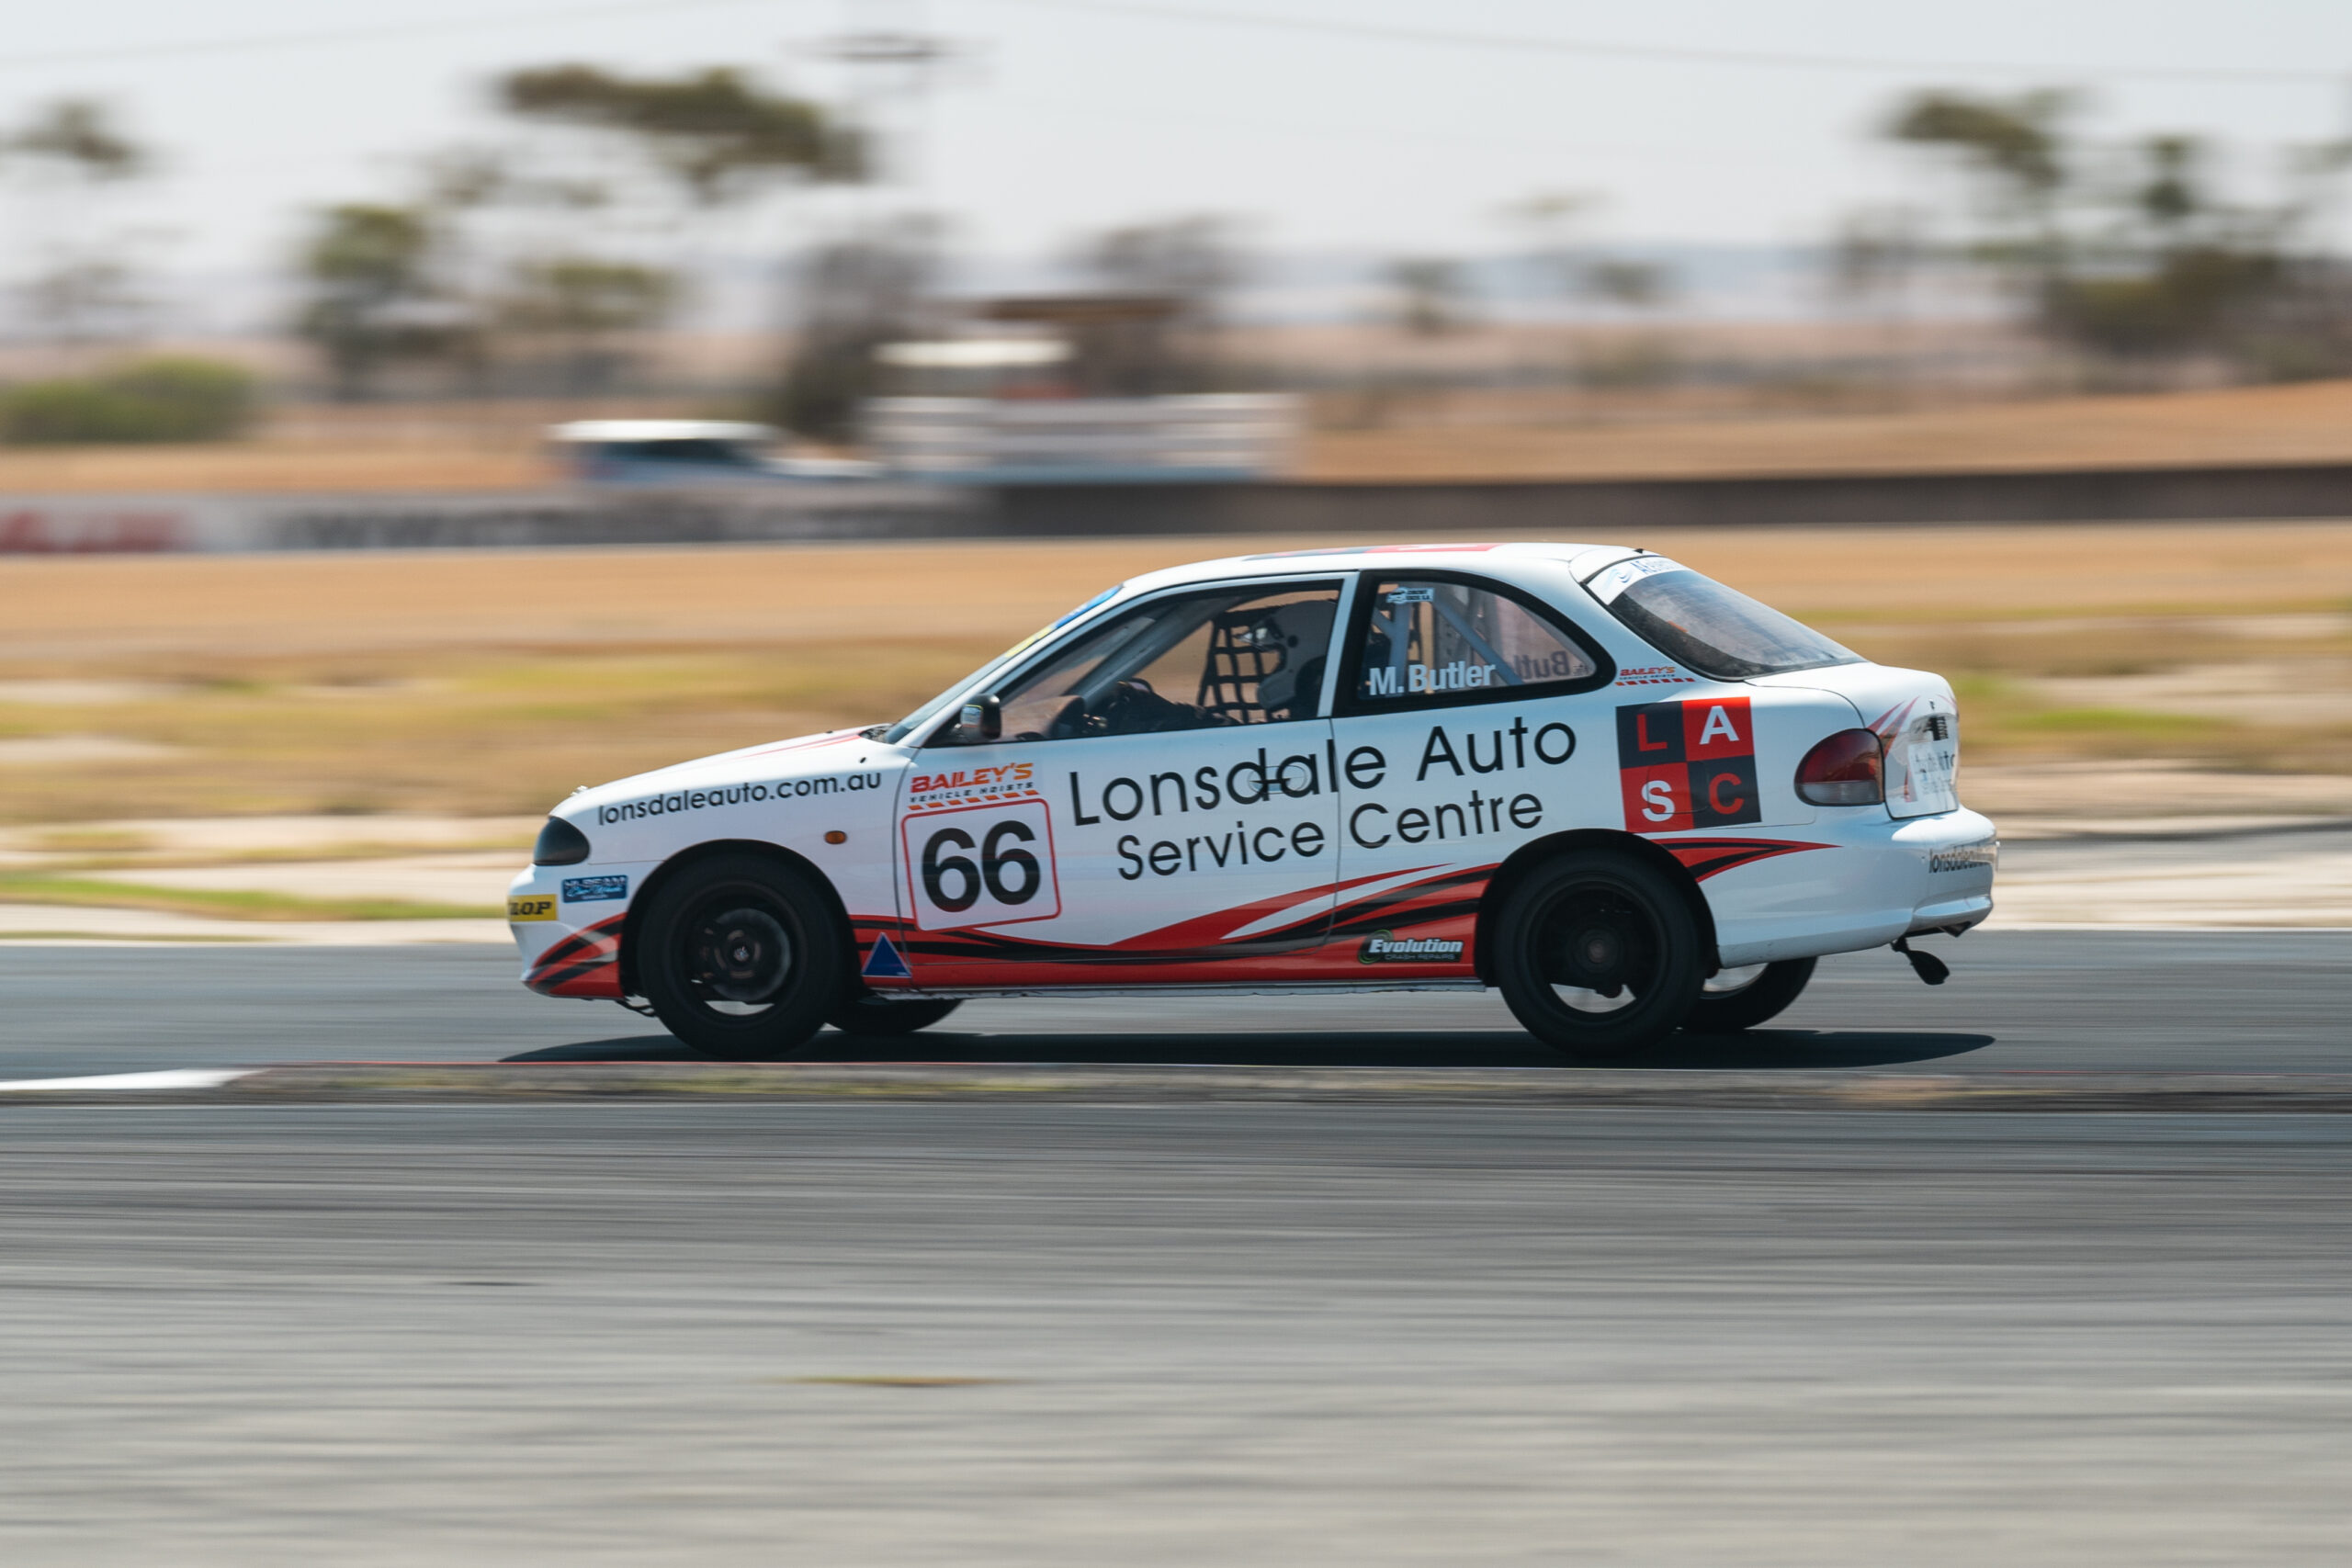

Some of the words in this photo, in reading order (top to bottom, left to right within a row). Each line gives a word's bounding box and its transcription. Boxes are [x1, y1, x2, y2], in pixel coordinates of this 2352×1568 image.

[1368, 667, 1404, 696] M.
[1408, 661, 1497, 694] Butler
[1620, 666, 1676, 677] BAILEY'S
[1635, 713, 1668, 752] L
[1699, 705, 1739, 745] A
[910, 761, 1035, 794] BAILEY'S
[1069, 739, 1386, 827] Lonsdale
[1416, 716, 1577, 782] Auto
[597, 771, 882, 827] lonsdaleauto.com.au
[910, 789, 973, 804] VEHICLE
[978, 781, 1035, 795] HOISTS
[1640, 779, 1677, 822] S
[1707, 772, 1746, 815] C
[1116, 820, 1325, 881] Service
[1349, 789, 1544, 850] Centre
[922, 819, 1042, 913] 66
[508, 901, 552, 916] LOP
[1368, 938, 1464, 953] Evolution
